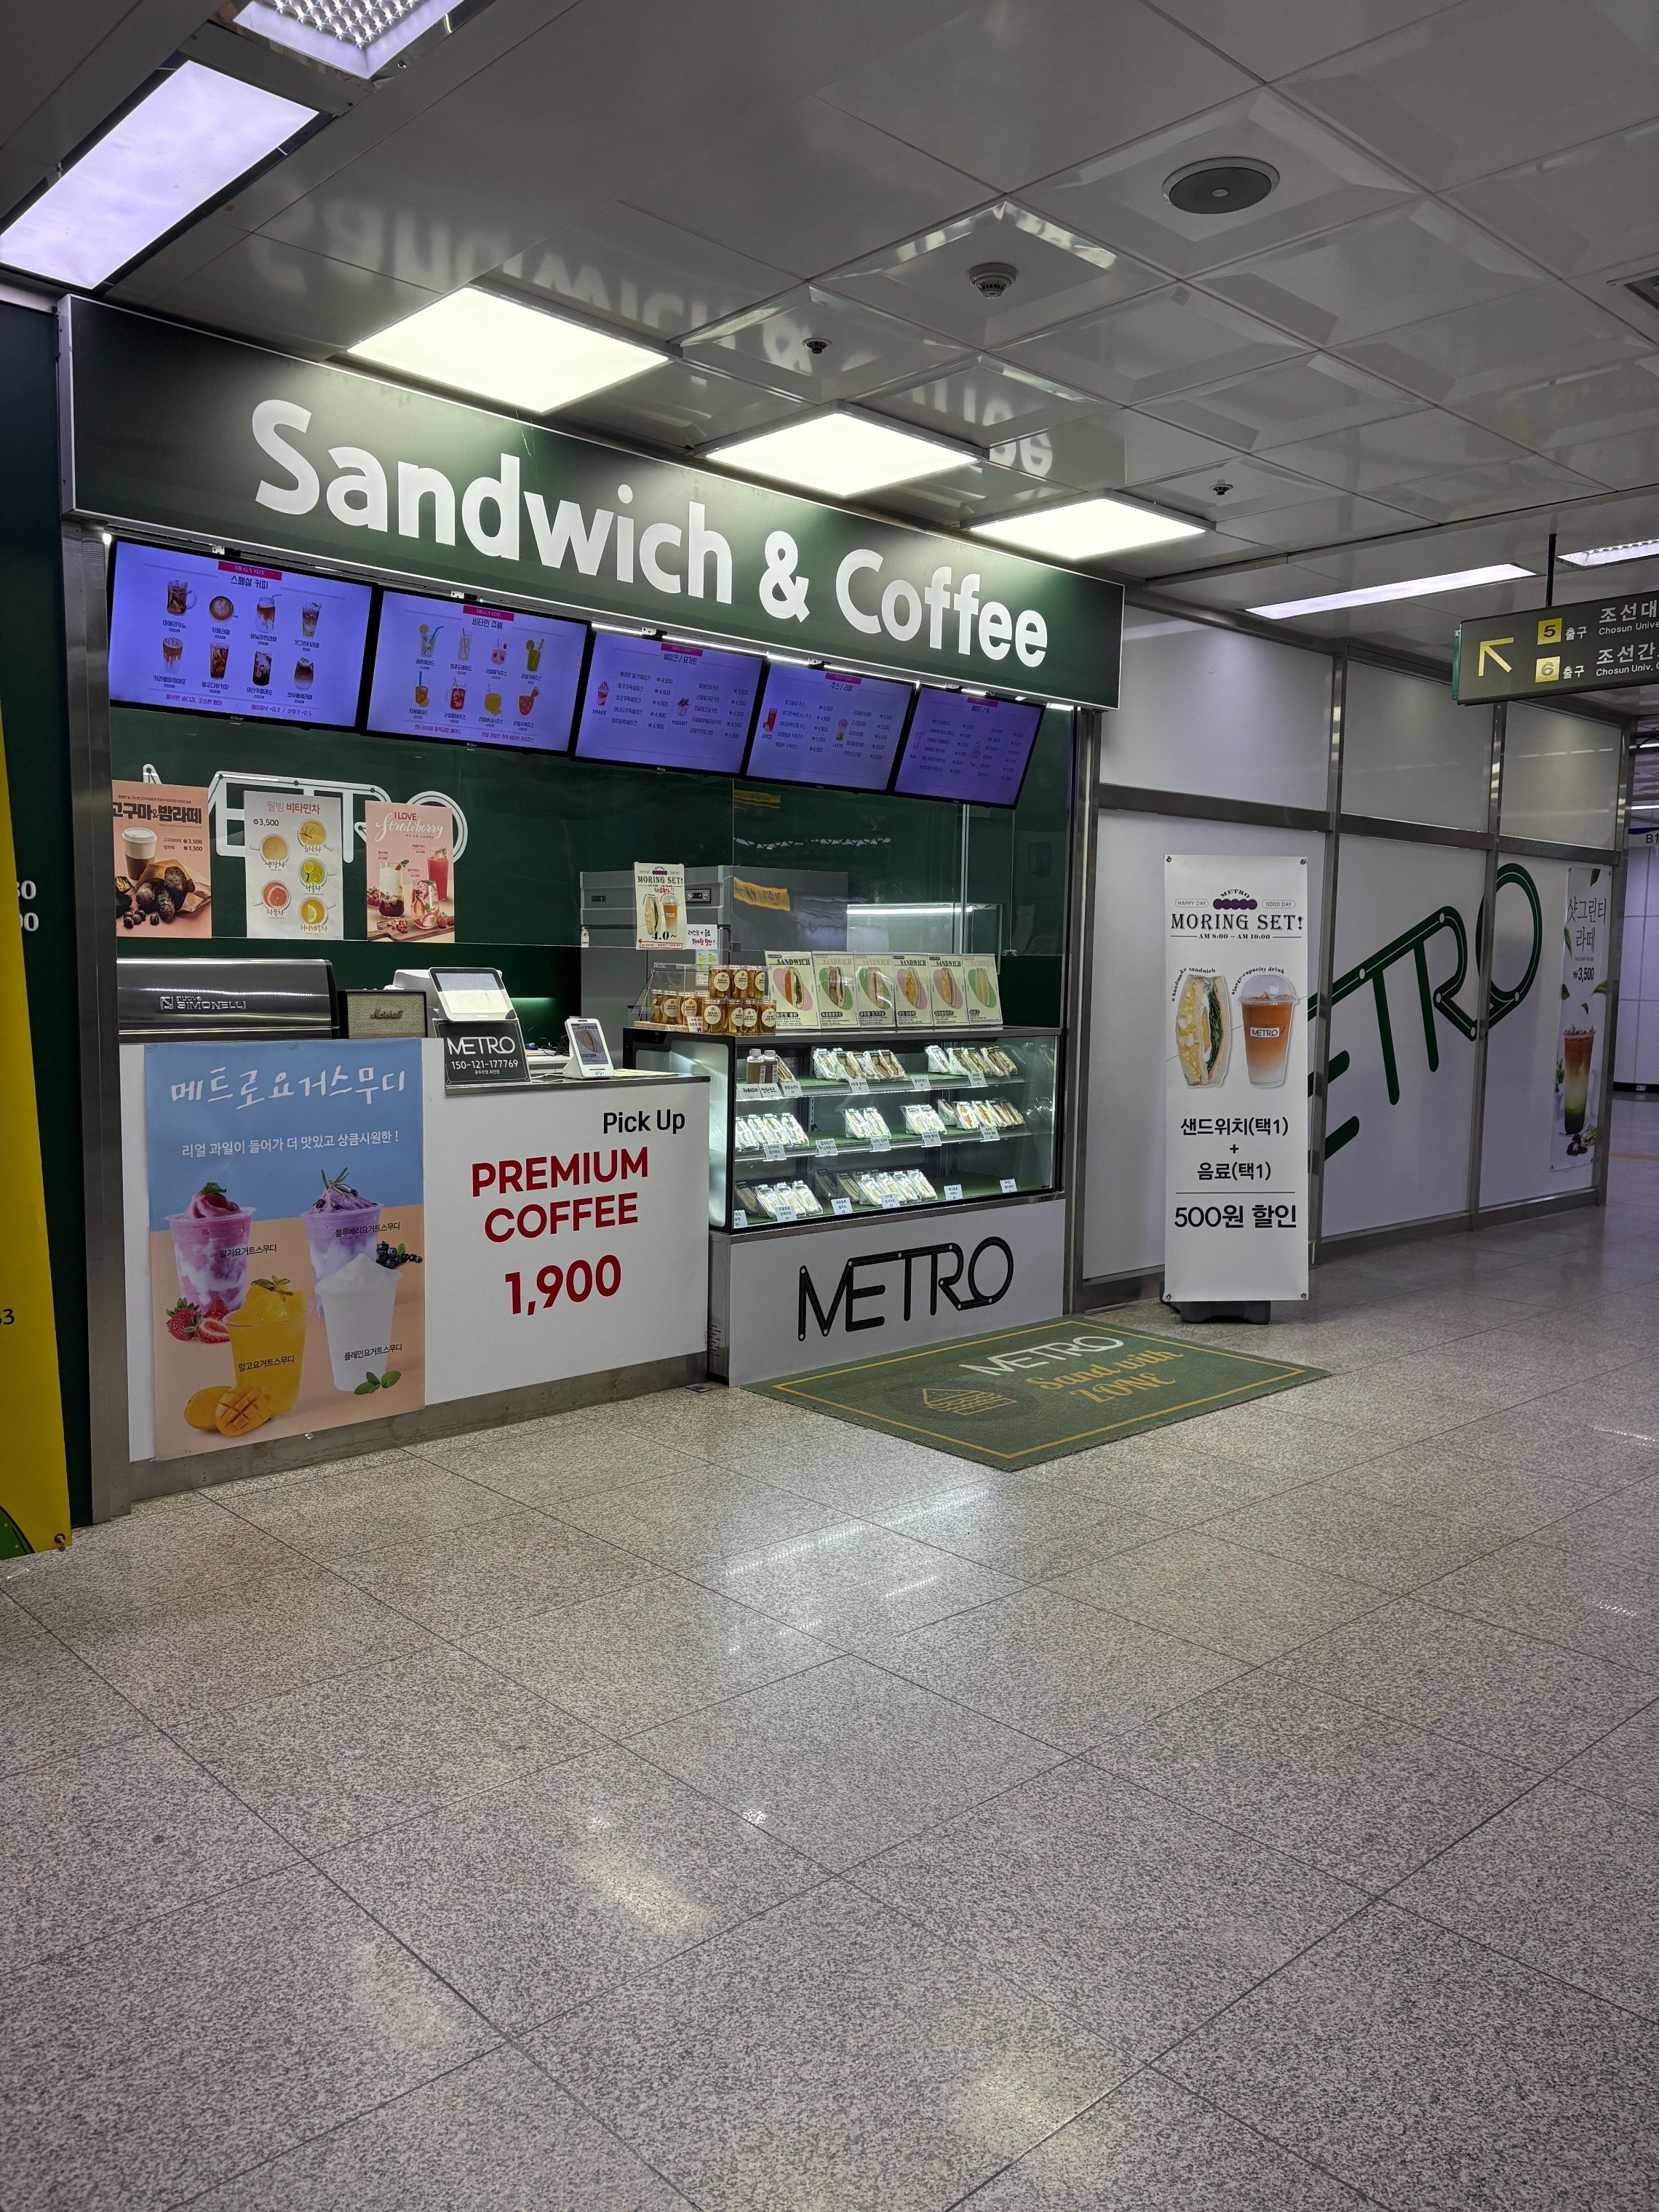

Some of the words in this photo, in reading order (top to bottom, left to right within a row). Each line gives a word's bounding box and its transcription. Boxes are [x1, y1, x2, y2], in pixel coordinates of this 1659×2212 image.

[252, 399, 732, 605] Sandwich
[759, 530, 809, 623] &
[835, 549, 1048, 668] Coffee
[230, 576, 252, 587] 스페셜
[254, 579, 268, 589] 커피
[163, 619, 186, 629] 아메리카노
[472, 617, 490, 628] 비타민
[1543, 624, 1556, 638] 5
[1566, 626, 1587, 640] 출구
[1599, 600, 1658, 623] 조선대
[1599, 624, 1632, 635] Chosun
[664, 653, 678, 662] 쉐이크
[683, 656, 697, 665] 요거트
[1541, 662, 1553, 676] 6
[1564, 665, 1585, 679] 출구
[1596, 667, 1629, 677] Chosun
[1631, 663, 1654, 673] Univ.
[267, 800, 285, 813] 웰빙
[287, 803, 320, 814] 비타민차
[259, 819, 279, 827] 3,500
[398, 812, 416, 821] LOVE
[375, 813, 443, 843] Strawberry
[637, 875, 665, 883] MORING
[1220, 889, 1250, 899] METRO
[1567, 896, 1607, 925] 샷그린티
[1170, 913, 1249, 930] MORING
[1257, 915, 1304, 931] SET!
[1576, 926, 1596, 953] 라떼
[1173, 968, 1187, 997] handmade
[1573, 967, 1594, 982] ₩3,500
[177, 1001, 247, 1009] SIMONELLI
[370, 1008, 403, 1019] Marshall
[1252, 1029, 1278, 1037] METRO
[447, 1036, 516, 1055] METRO
[451, 1059, 518, 1070] 150-121-177769
[171, 1065, 405, 1110] 메트로요거스무디
[603, 1110, 651, 1134] Pick
[657, 1109, 685, 1134] Up
[1180, 1117, 1289, 1136] 샌드위치(택1)
[182, 1142, 207, 1158] 리얼
[209, 1139, 246, 1155] 과일이
[248, 1137, 284, 1153] 들어가
[287, 1137, 298, 1151] 더
[301, 1134, 335, 1150] 맛있고
[338, 1130, 392, 1148] 상큼시원한
[1230, 1144, 1239, 1153] +
[472, 1147, 648, 1198] PREMIUM
[1197, 1161, 1271, 1181] 음료(택1)
[485, 1192, 639, 1243] COFFEE
[1174, 1205, 1244, 1228] 500원
[1252, 1205, 1297, 1228] 할인
[335, 1222, 400, 1238] 블루베리요거트스무디
[219, 1244, 277, 1259] 딸기요거트스무디
[505, 1254, 621, 1316] 1,900
[797, 1236, 1014, 1342] METRO
[343, 1343, 402, 1361] 플레인요거트스무디
[958, 1336, 1124, 1376] METRO
[238, 1355, 295, 1372] 망고요거트스무디
[1025, 1364, 1123, 1391] Sand
[1114, 1350, 1185, 1369] with
[1070, 1372, 1176, 1403] ZONE
